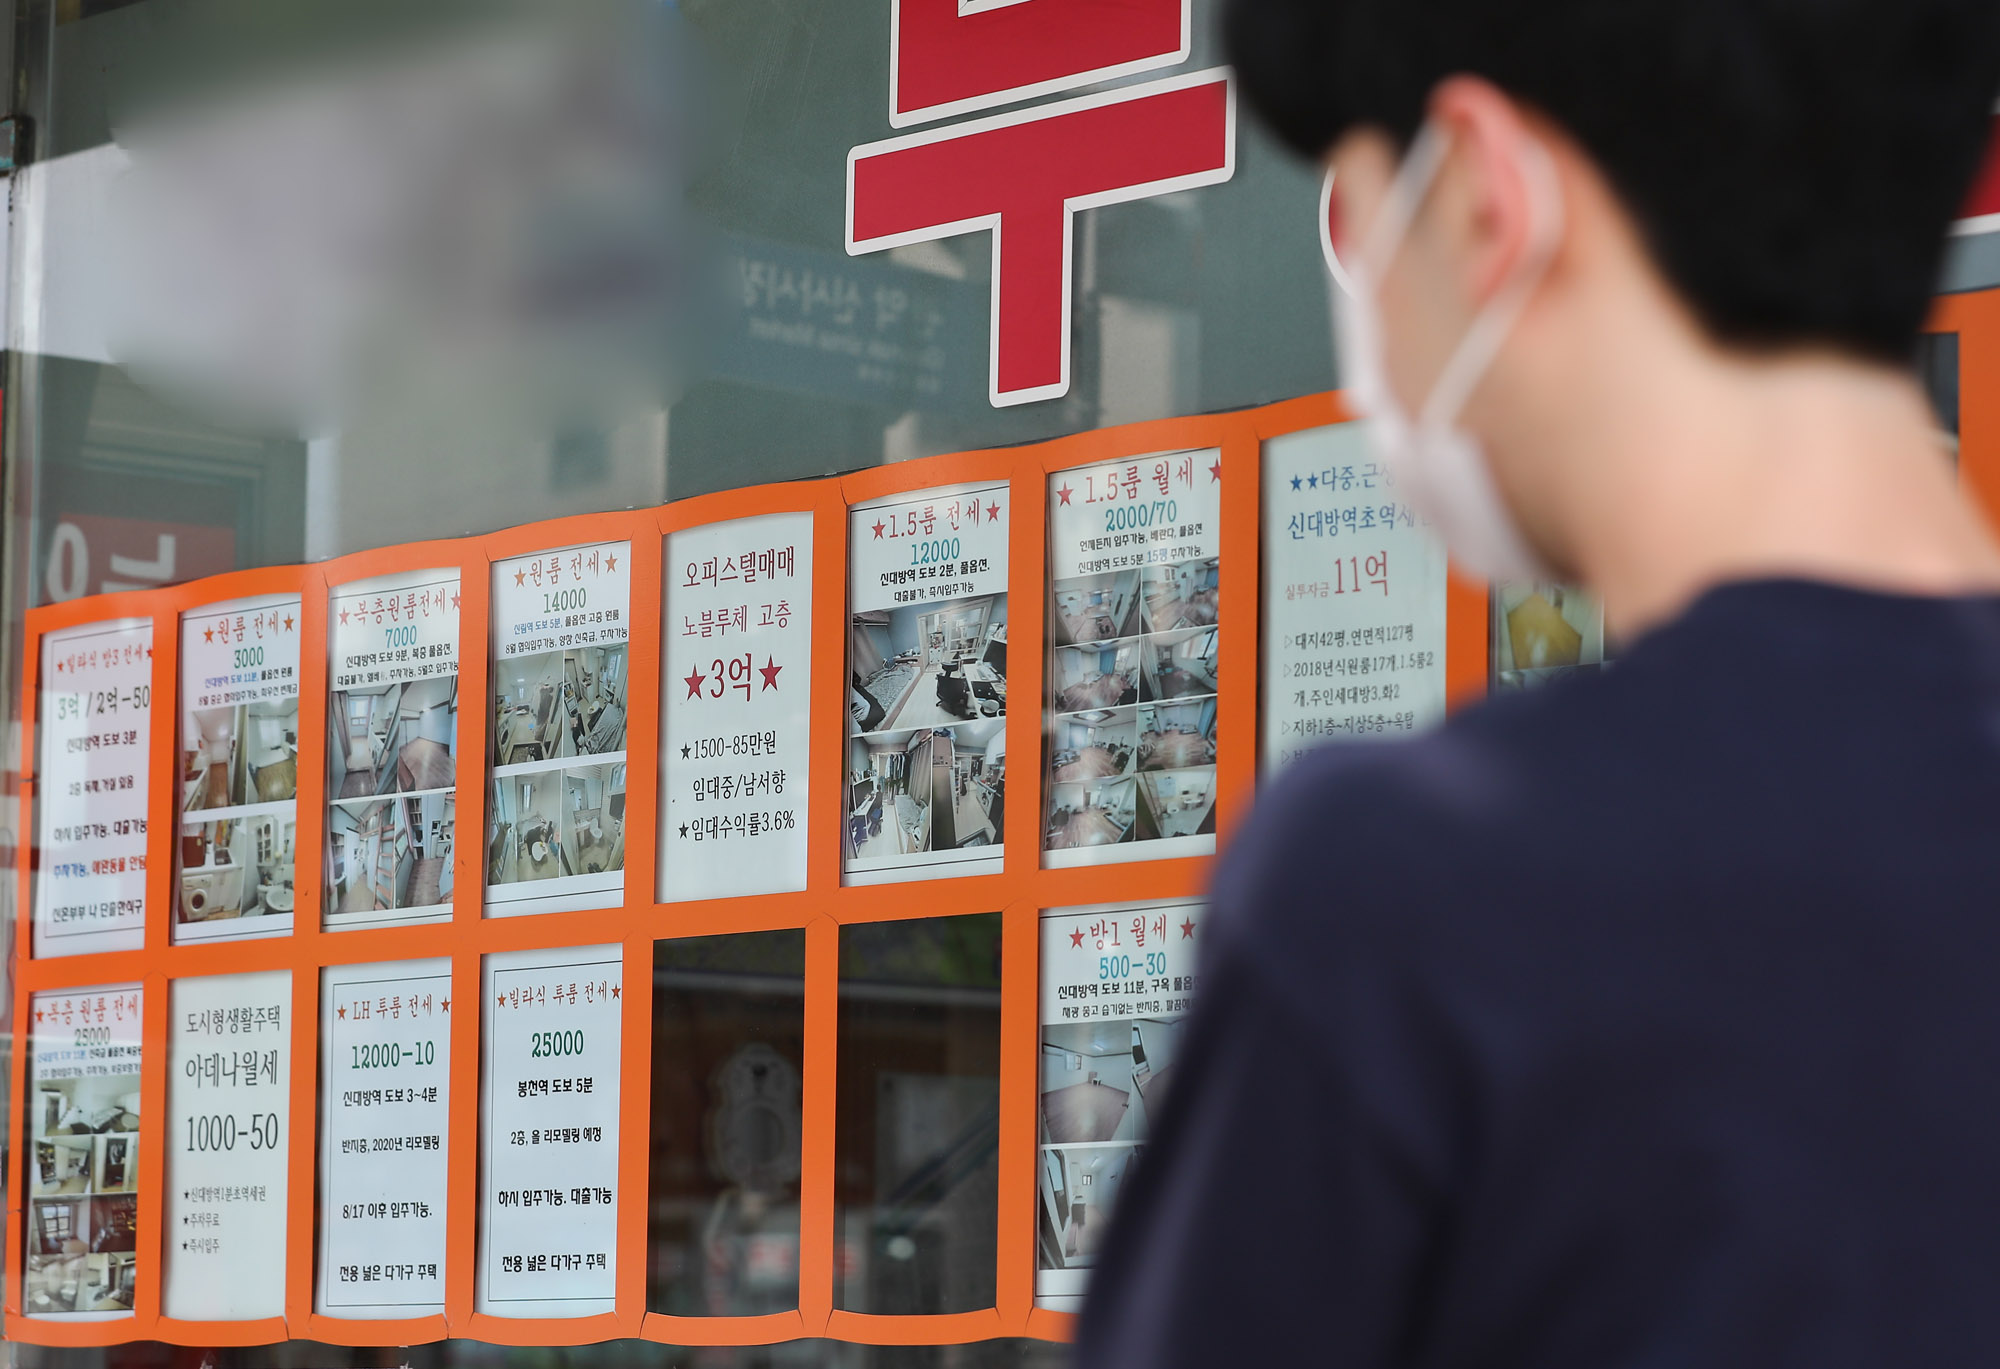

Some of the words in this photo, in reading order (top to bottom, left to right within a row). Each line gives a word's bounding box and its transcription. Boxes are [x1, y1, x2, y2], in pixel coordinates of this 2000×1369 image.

[1085, 465, 1142, 504] 1.5룸
[1152, 456, 1193, 496] 월세
[889, 505, 937, 538] 1.5룸
[946, 498, 980, 531] 전세
[1105, 500, 1177, 532] 2000/70
[1288, 502, 1433, 540] 신대방역초역세
[1080, 537, 1112, 552] 언제든지
[1179, 523, 1202, 537] 풀옵션
[911, 537, 960, 566] 12000
[1078, 558, 1110, 574] 신대방역
[1113, 556, 1128, 567] 도보
[1131, 553, 1144, 566] 5분
[1147, 548, 1168, 563] 15평
[530, 557, 561, 587] 원룸
[570, 550, 599, 580] 전세
[682, 546, 795, 587] 오피스텔매매
[880, 569, 916, 587] 신대방역
[919, 566, 936, 579] 도보
[1285, 582, 1330, 600] 실투자금
[1335, 550, 1388, 597] 11억
[544, 587, 586, 613] 14000
[929, 581, 974, 597] 즉시입주가능
[218, 616, 245, 644] 원룸
[254, 611, 278, 639] 전세
[514, 621, 533, 635] 신림역
[536, 620, 548, 630] 도보
[565, 614, 586, 627] 풀옵션
[589, 611, 602, 623] 고층
[605, 609, 619, 621] 원룸
[682, 605, 747, 638] 노블루체
[757, 600, 792, 628] 고층
[385, 625, 417, 648] 7000
[600, 627, 628, 640] 주차가능
[234, 646, 264, 669] 3000
[346, 654, 376, 668] 신대방역
[379, 651, 393, 662] 도보
[413, 646, 426, 659] 복층
[436, 661, 458, 673] 입주가능
[710, 652, 752, 702] 3억
[58, 692, 78, 720] 3억
[103, 732, 119, 746] 도보
[123, 731, 137, 745] 3분
[694, 730, 776, 759] 1500-85만원
[693, 769, 786, 802] 임대중/남서향
[692, 810, 795, 841] 임대수익률3.6%
[1090, 919, 1120, 950] 방1
[1130, 913, 1167, 947] 월세
[1100, 952, 1166, 980] 500-30
[509, 985, 546, 1009] 빌라식
[553, 982, 578, 1006] 투룸
[584, 980, 607, 1003] 전세
[1058, 984, 1098, 1000] 신대방역
[1102, 982, 1120, 995] 도보
[1152, 977, 1170, 992] 구옥
[80, 997, 106, 1023] 원룸
[114, 994, 138, 1021] 전세
[186, 1005, 280, 1035] 도시형생활주택
[353, 1001, 371, 1020] LH
[376, 996, 402, 1020] 투룸
[408, 993, 432, 1018] 전세
[1102, 1003, 1133, 1017] 습기없는
[75, 1026, 110, 1047] 25000
[531, 1029, 584, 1057] 25000
[352, 1040, 434, 1069] 12000-10
[186, 1049, 278, 1088] 아데나월세
[343, 1089, 381, 1107] 신대방역
[385, 1089, 403, 1103] 도보
[407, 1087, 437, 1103] 3~4분
[518, 1079, 548, 1098] 봉천역
[552, 1078, 572, 1093] 도보
[576, 1077, 593, 1093] 5분
[187, 1112, 279, 1152] 1000-50
[373, 1138, 402, 1151] 2020년
[406, 1135, 440, 1150] 리모델링
[531, 1129, 540, 1144] 올
[544, 1128, 580, 1143] 리모델링
[583, 1127, 601, 1142] 예정
[343, 1204, 364, 1219] 8/17
[368, 1202, 387, 1219] 이후
[499, 1190, 518, 1207] 하시
[571, 1187, 612, 1205] 대출가능
[190, 1213, 220, 1229] 주차무료
[190, 1238, 220, 1254] 즉시입주
[340, 1265, 359, 1282] 전용
[363, 1265, 381, 1281] 넓은
[385, 1264, 414, 1281] 다가구
[418, 1264, 437, 1280] 주택
[502, 1255, 522, 1273] 전용
[527, 1255, 546, 1272] 넓은
[551, 1254, 582, 1271] 다가구
[586, 1253, 606, 1270] 주택
